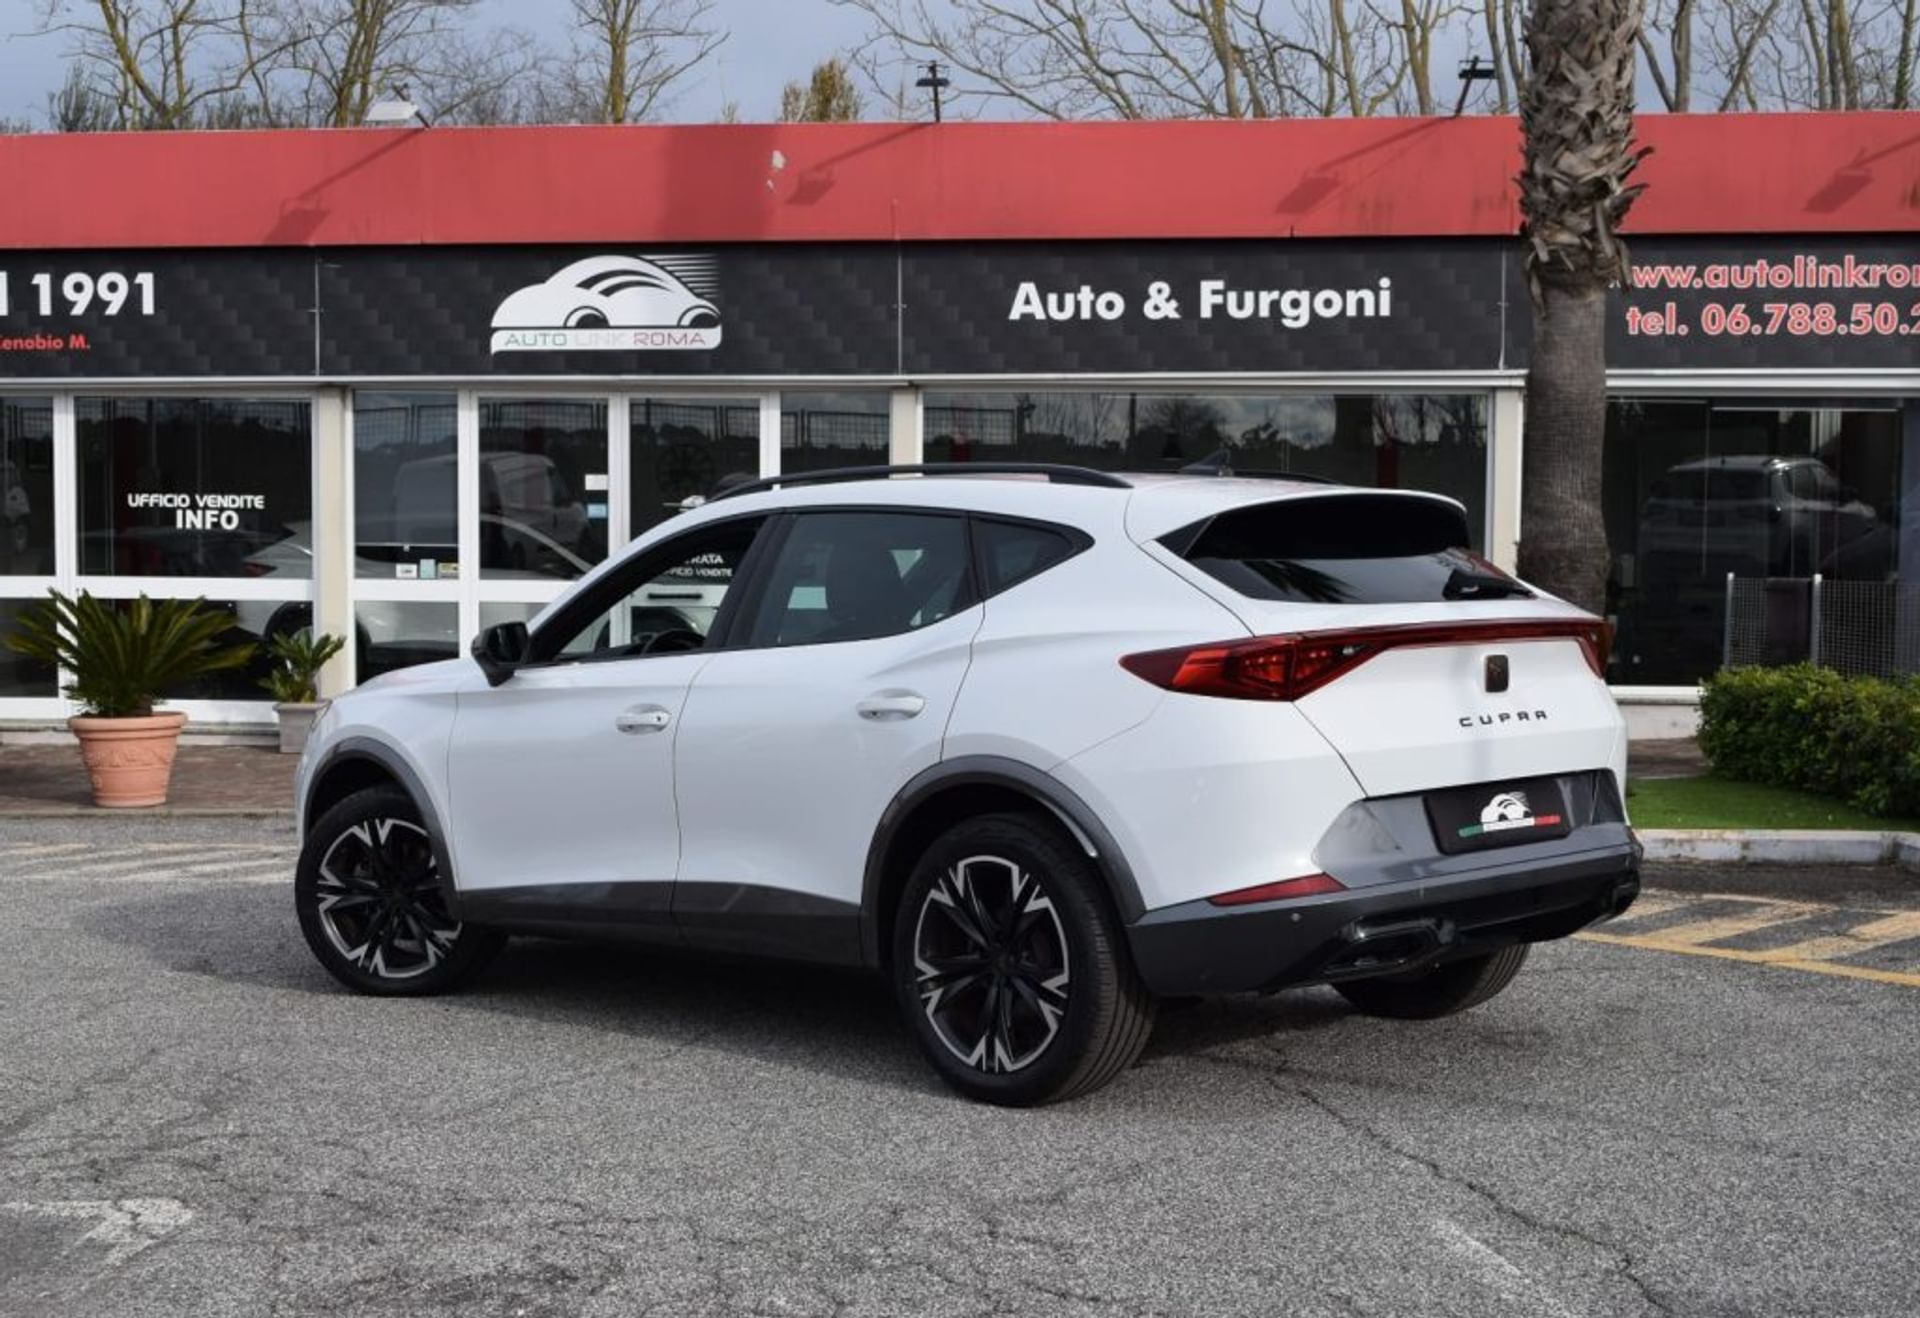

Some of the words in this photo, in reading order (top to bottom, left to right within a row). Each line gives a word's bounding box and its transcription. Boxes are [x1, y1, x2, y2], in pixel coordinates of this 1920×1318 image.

[1608, 255, 1920, 288] ww.autolinkro
[31, 272, 155, 316] 1991
[1008, 282, 1125, 320] Auto
[1143, 281, 1181, 319] &
[1199, 277, 1392, 329] Furgoni
[1626, 302, 1689, 335] tel.
[0, 333, 64, 349] enobio
[69, 334, 91, 349] M.
[504, 332, 567, 346] AUTO
[633, 332, 706, 345] ROMA
[127, 493, 190, 507] UFFICIO
[195, 494, 265, 509] VENDITE
[176, 509, 239, 530] INFO
[1459, 710, 1548, 728] CUPRA
